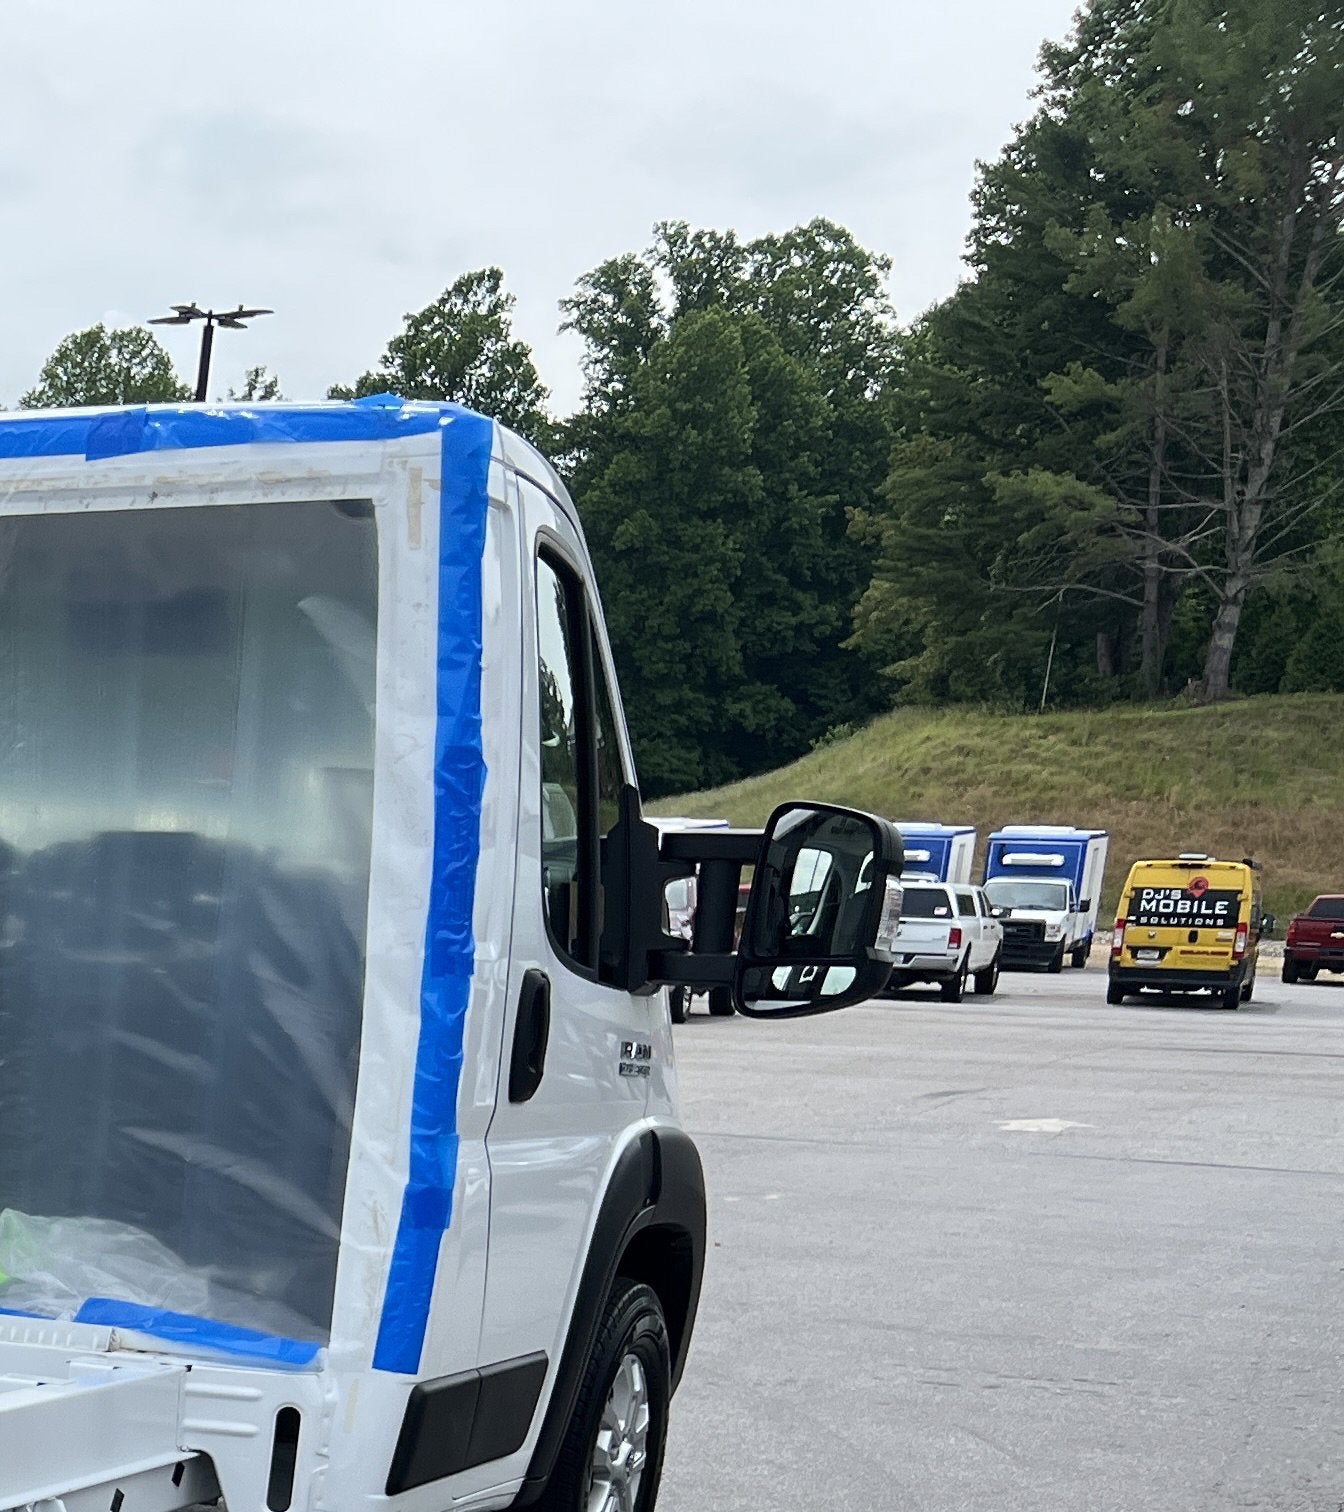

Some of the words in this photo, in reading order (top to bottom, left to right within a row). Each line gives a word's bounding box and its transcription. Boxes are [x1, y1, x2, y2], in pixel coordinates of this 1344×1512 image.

[1142, 889, 1182, 900] DJ'S
[1140, 900, 1229, 915] MOBILE
[1140, 917, 1224, 926] SOLUTIONS
